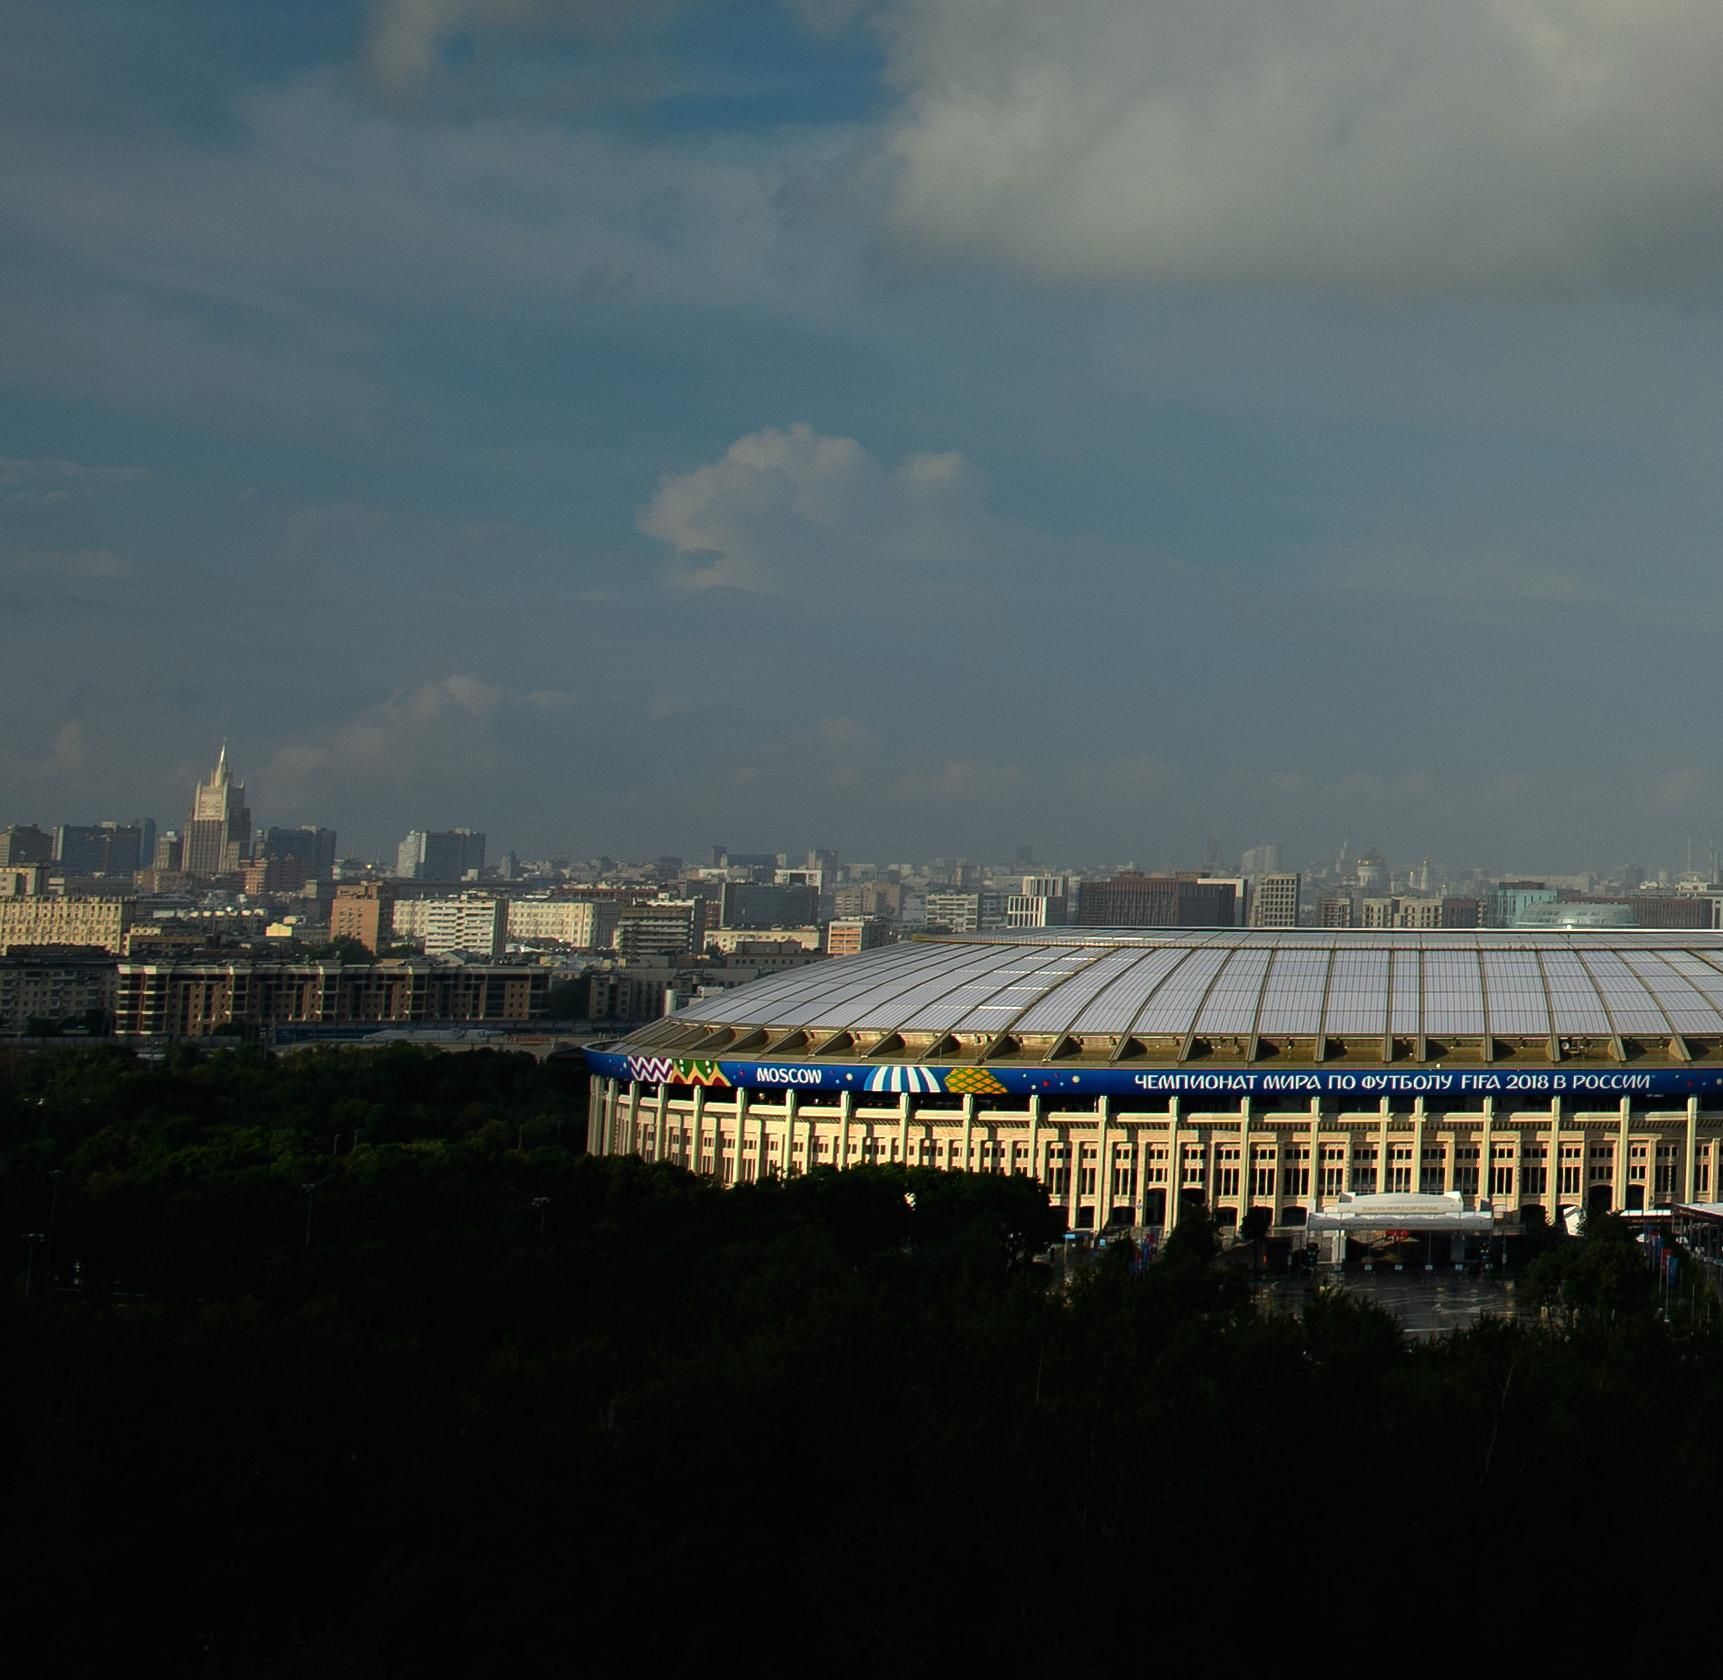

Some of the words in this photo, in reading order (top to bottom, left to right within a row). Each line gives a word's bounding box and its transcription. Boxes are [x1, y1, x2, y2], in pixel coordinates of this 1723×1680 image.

[756, 1067, 822, 1084] MOSCOW
[1134, 1074, 1258, 1090] ЧЕМПИОНАТ
[1263, 1075, 1322, 1090] МИРА
[1328, 1075, 1356, 1090] ПО
[1361, 1075, 1453, 1090] ФУТБОЛУ
[1461, 1074, 1501, 1089] FIFA
[1505, 1074, 1549, 1089] 2018
[1553, 1075, 1567, 1089] В
[1572, 1074, 1650, 1089] РОССИИ
